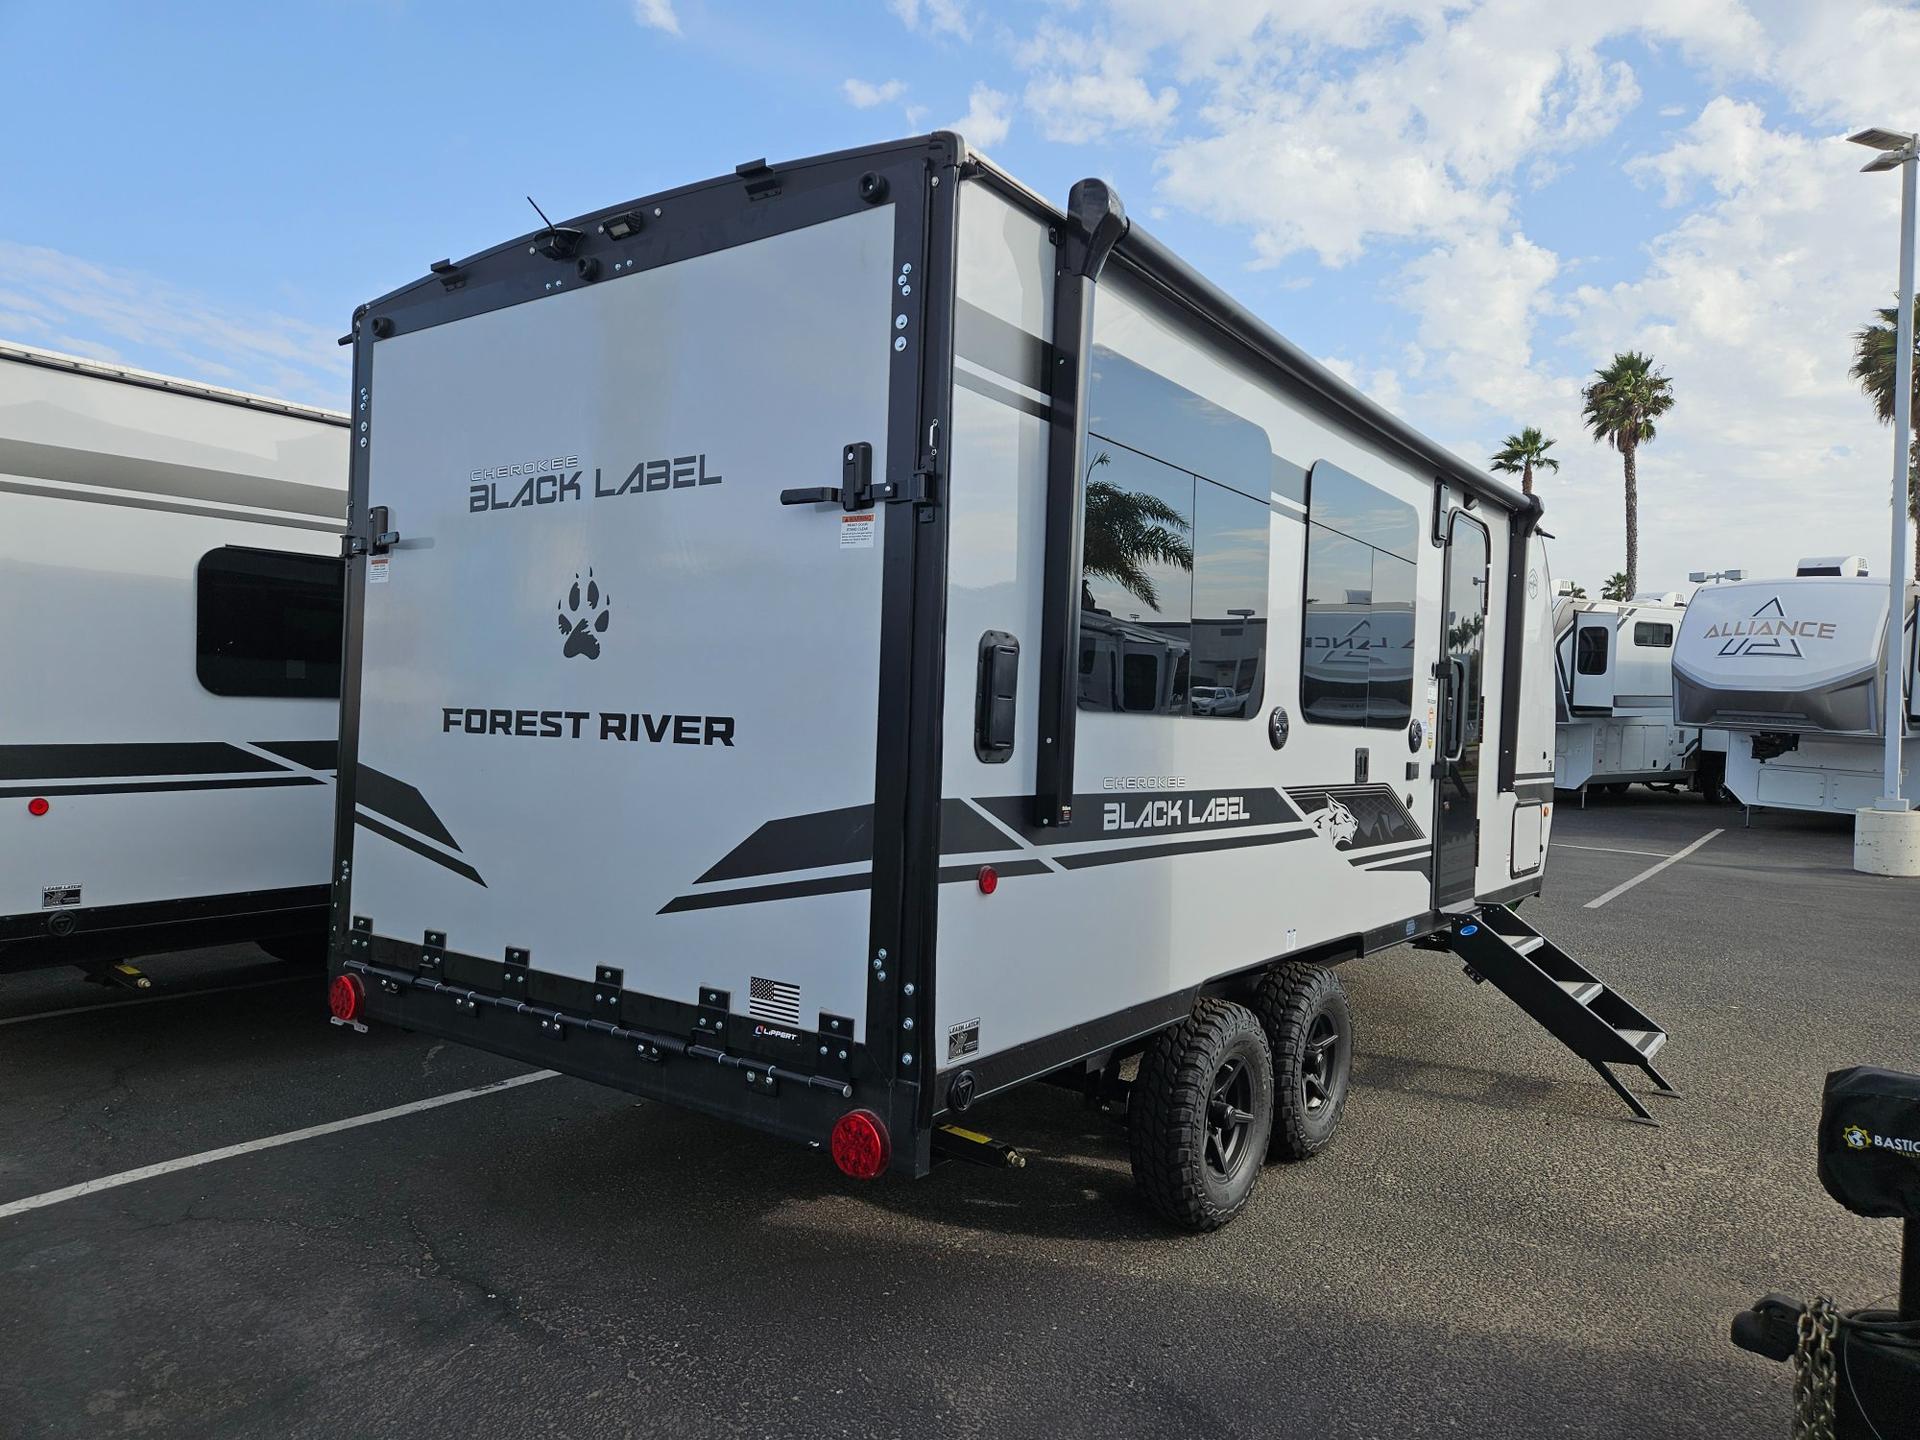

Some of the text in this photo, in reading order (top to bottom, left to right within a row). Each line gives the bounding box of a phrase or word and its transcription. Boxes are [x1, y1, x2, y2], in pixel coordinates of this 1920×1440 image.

[469, 454, 723, 513] BLACK LABEL
[470, 455, 579, 482] CHEROKEE
[1703, 620, 1837, 640] ALLIANCE
[442, 708, 735, 747] FOREST RIVER
[1103, 776, 1186, 789] CHEROKEE
[1103, 800, 1183, 831] BLACK
[1188, 796, 1250, 825] LABEL
